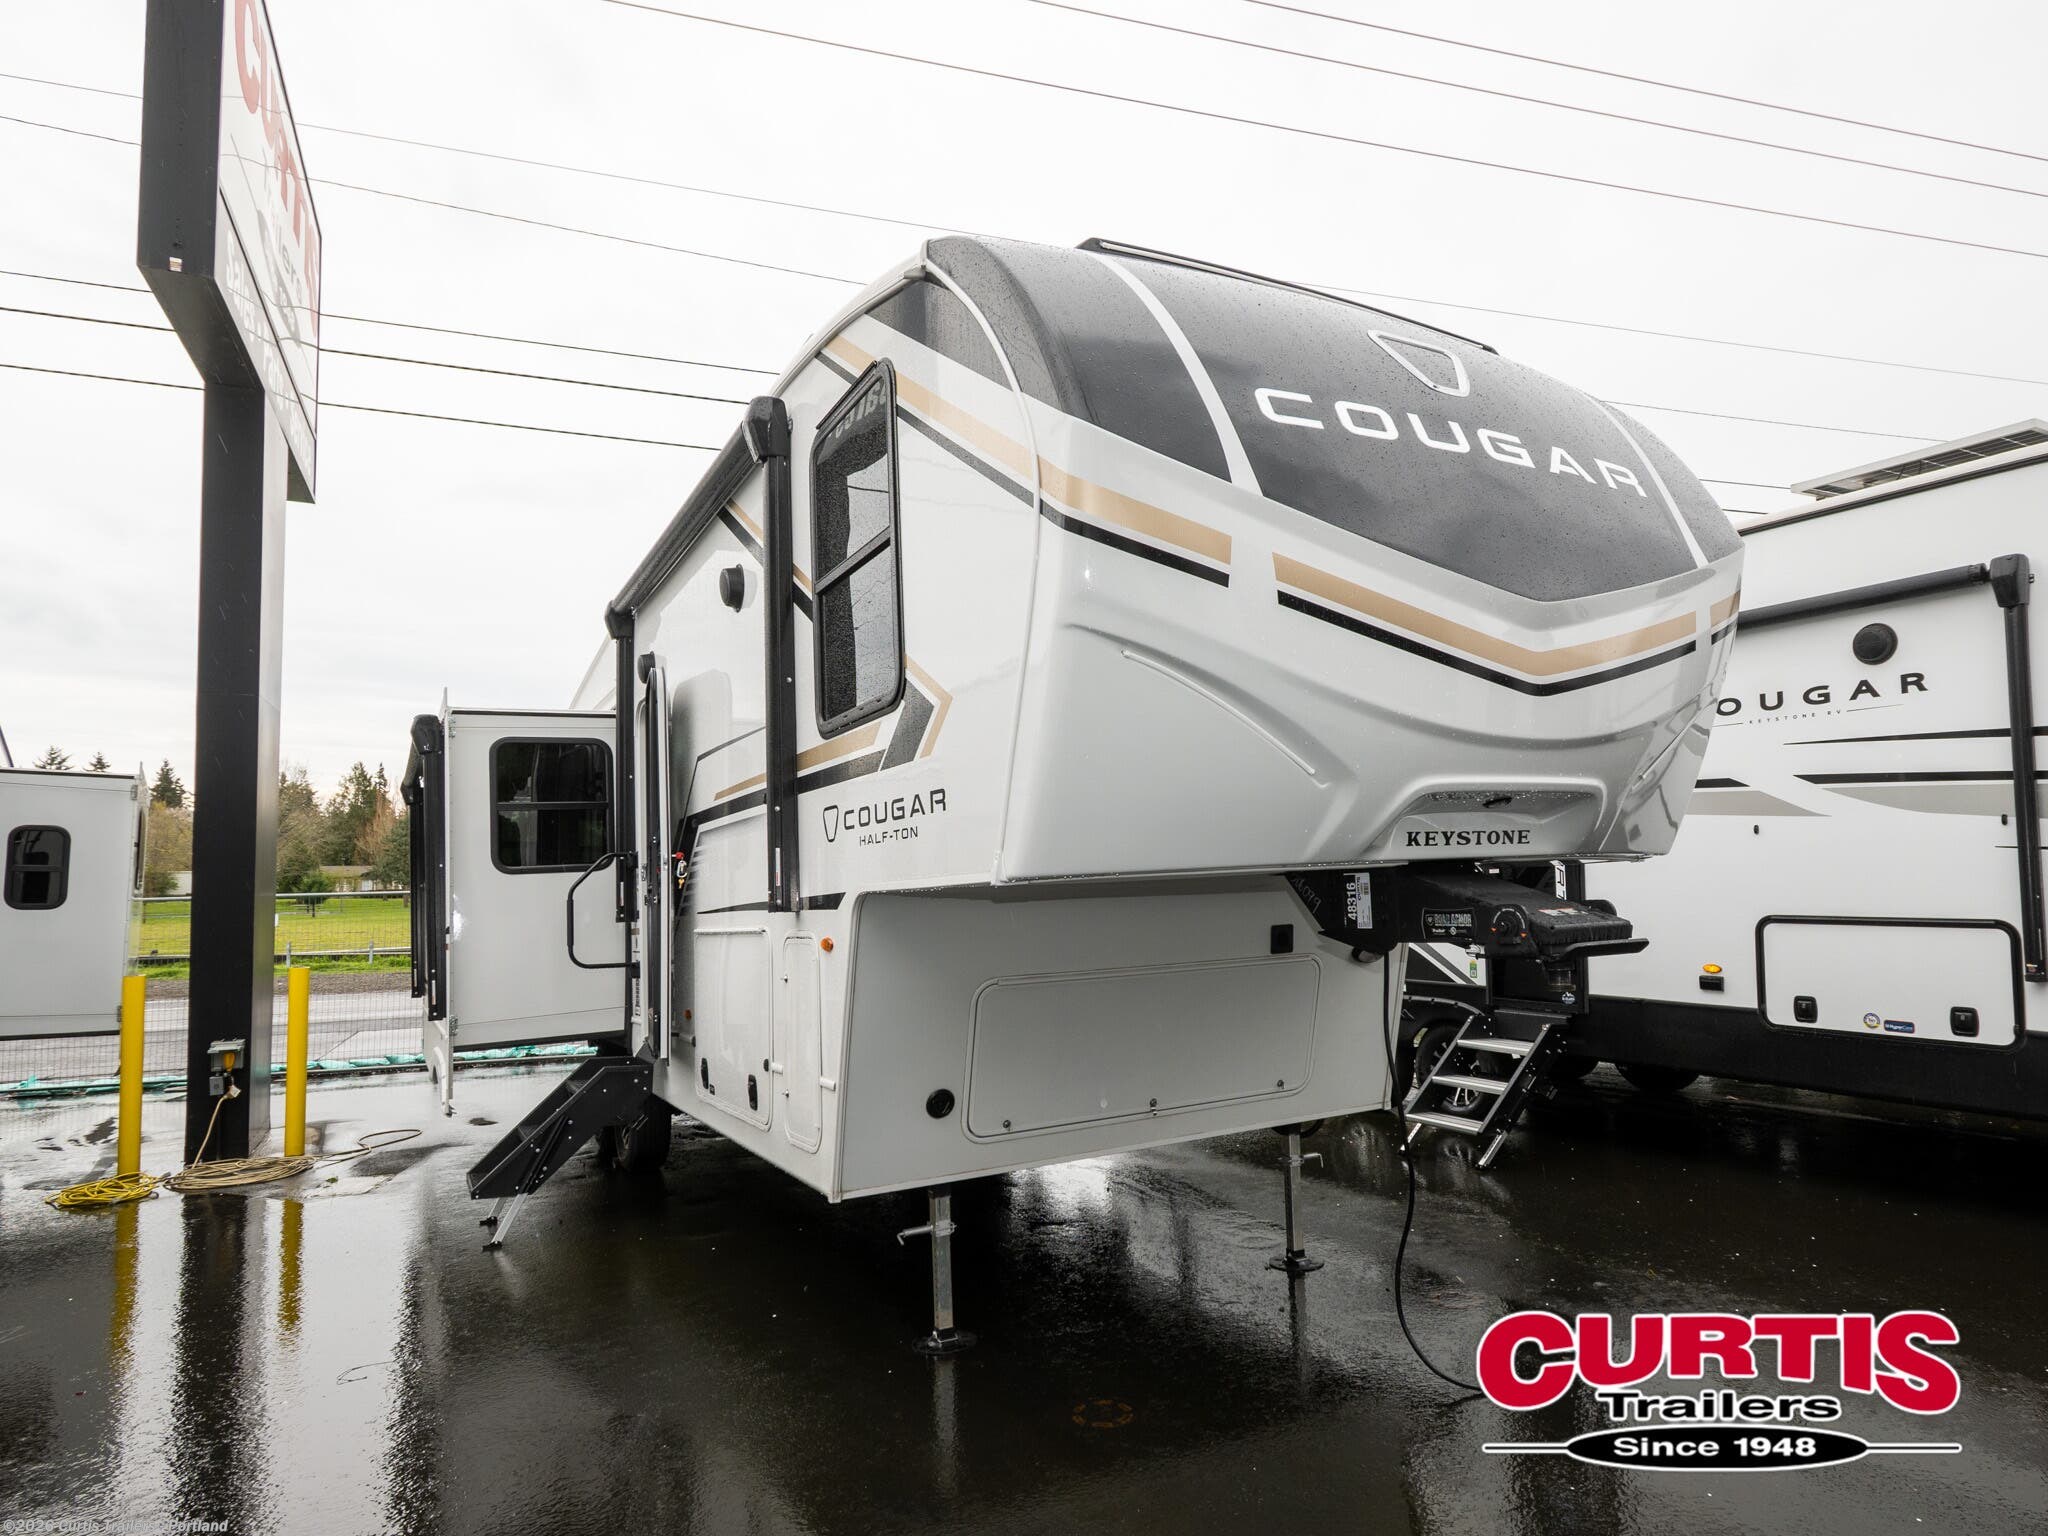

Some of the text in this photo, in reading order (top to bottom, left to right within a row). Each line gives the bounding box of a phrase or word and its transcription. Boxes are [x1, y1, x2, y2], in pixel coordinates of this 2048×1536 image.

[234, 0, 320, 336] CURTIS
[1254, 388, 1648, 498] COUGAR
[1716, 672, 1929, 717] OUGAR
[1749, 712, 1817, 725] KEYSTONE
[843, 788, 946, 830] COUGAR
[859, 826, 919, 847] HALF-TON
[1406, 829, 1531, 847] KEYSTONE
[1346, 882, 1357, 921] 48316
